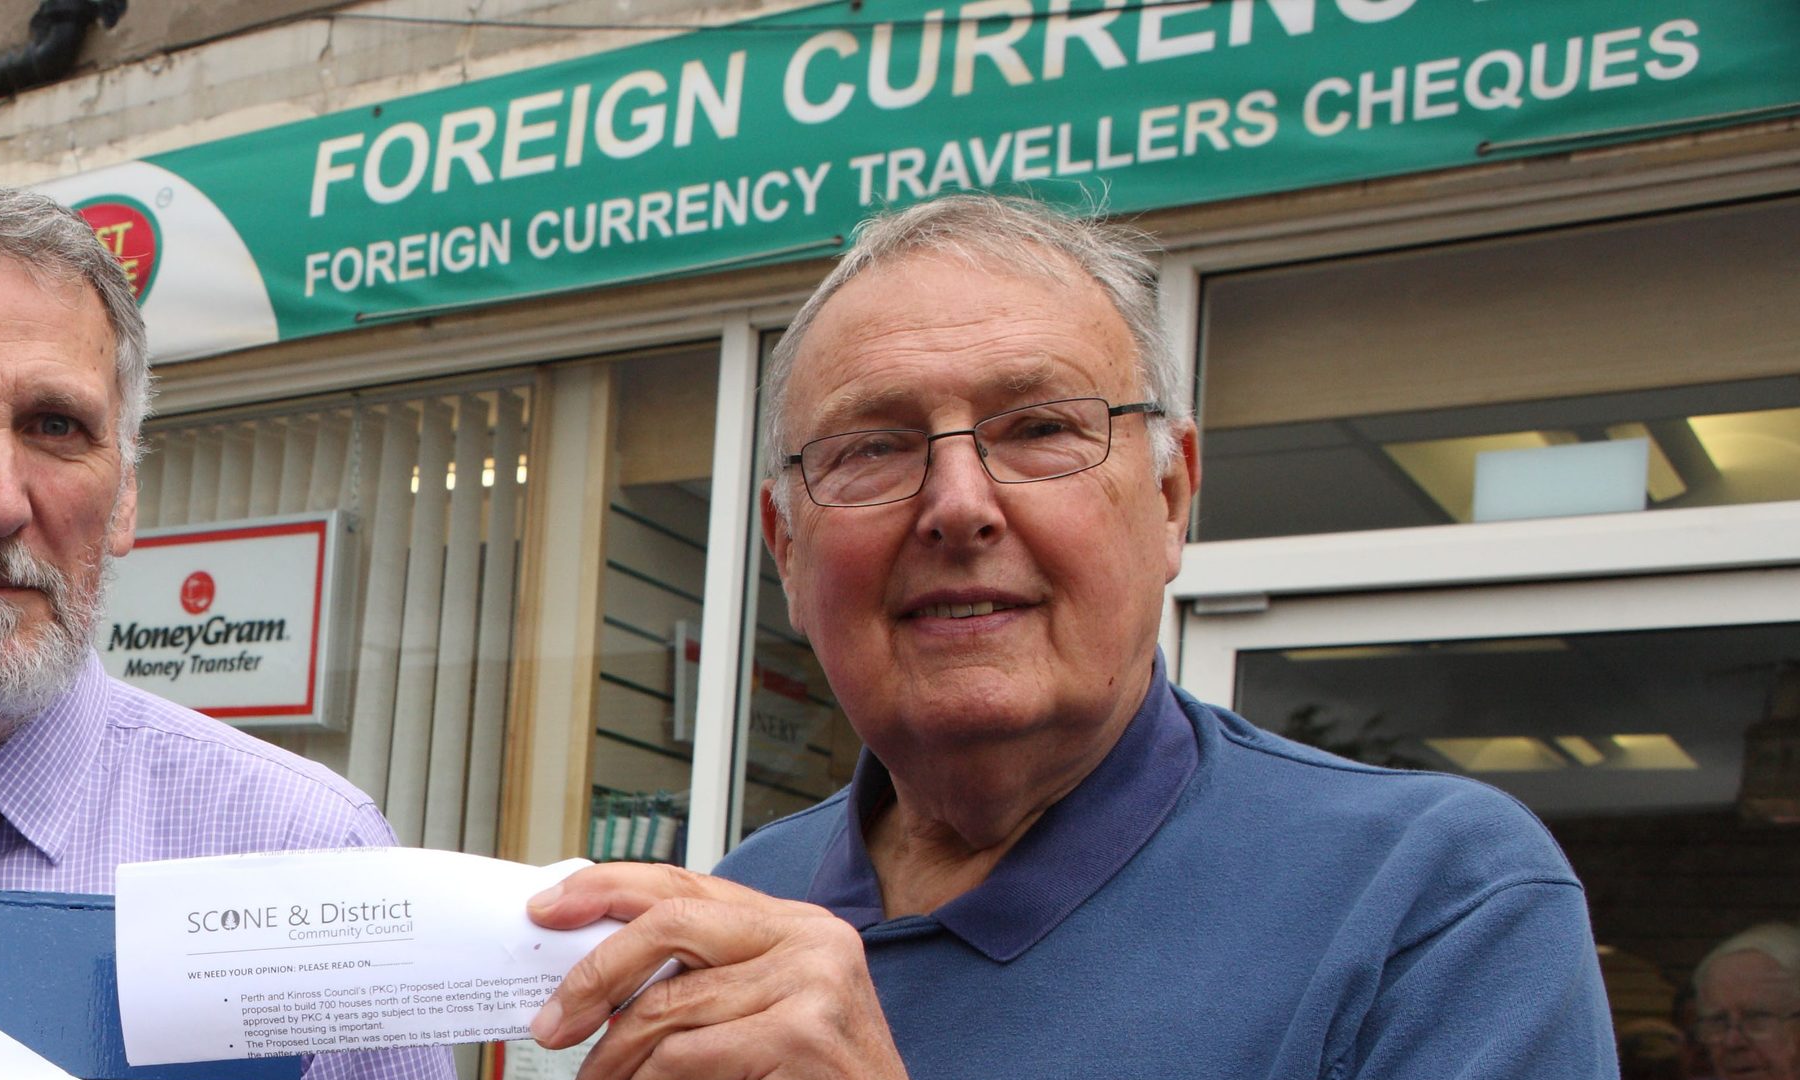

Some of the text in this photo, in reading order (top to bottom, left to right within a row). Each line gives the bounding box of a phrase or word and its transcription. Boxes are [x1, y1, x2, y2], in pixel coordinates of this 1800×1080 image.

[309, 51, 746, 218] FOREIGN
[305, 18, 1700, 297] FOREIGN CURRENCY TRAVELLERS CHEQUES
[108, 615, 286, 654] MoneyGram
[124, 650, 263, 681] Money Transfer
[187, 898, 412, 934] SCONE & District
[288, 921, 413, 941] Community Council
[187, 972, 202, 980] WE
[204, 969, 227, 978] NEED
[229, 968, 253, 977] YOUR
[255, 965, 296, 975] OPINION:
[299, 963, 329, 972] PLEASE
[332, 961, 355, 969] READ
[240, 973, 562, 1003] Perth and Kinross Council's (PKC) Proposed Local Development Plan
[241, 1003, 281, 1016] proposal
[283, 1002, 292, 1011] to
[294, 1001, 316, 1011] build
[318, 1000, 336, 1009] 700
[338, 998, 372, 1008] houses
[374, 996, 399, 1006] north
[401, 996, 410, 1004] of
[412, 993, 442, 1004] Scone
[445, 991, 491, 1003] extending
[494, 989, 509, 998] the
[512, 987, 543, 999] village
[243, 999, 545, 1027] approved by PKC 4 years ago subject to the Cross Tay Link Road
[244, 1021, 384, 1037] recognise housing is important.
[246, 1039, 264, 1048] The
[266, 1037, 309, 1049] Proposed
[312, 1036, 336, 1046] Local
[339, 1034, 360, 1044] Plan
[362, 1034, 380, 1042] was
[383, 1033, 407, 1042] open
[409, 1031, 418, 1040] to
[420, 1030, 430, 1038] its
[433, 1029, 450, 1038] last
[453, 1027, 481, 1039] public
